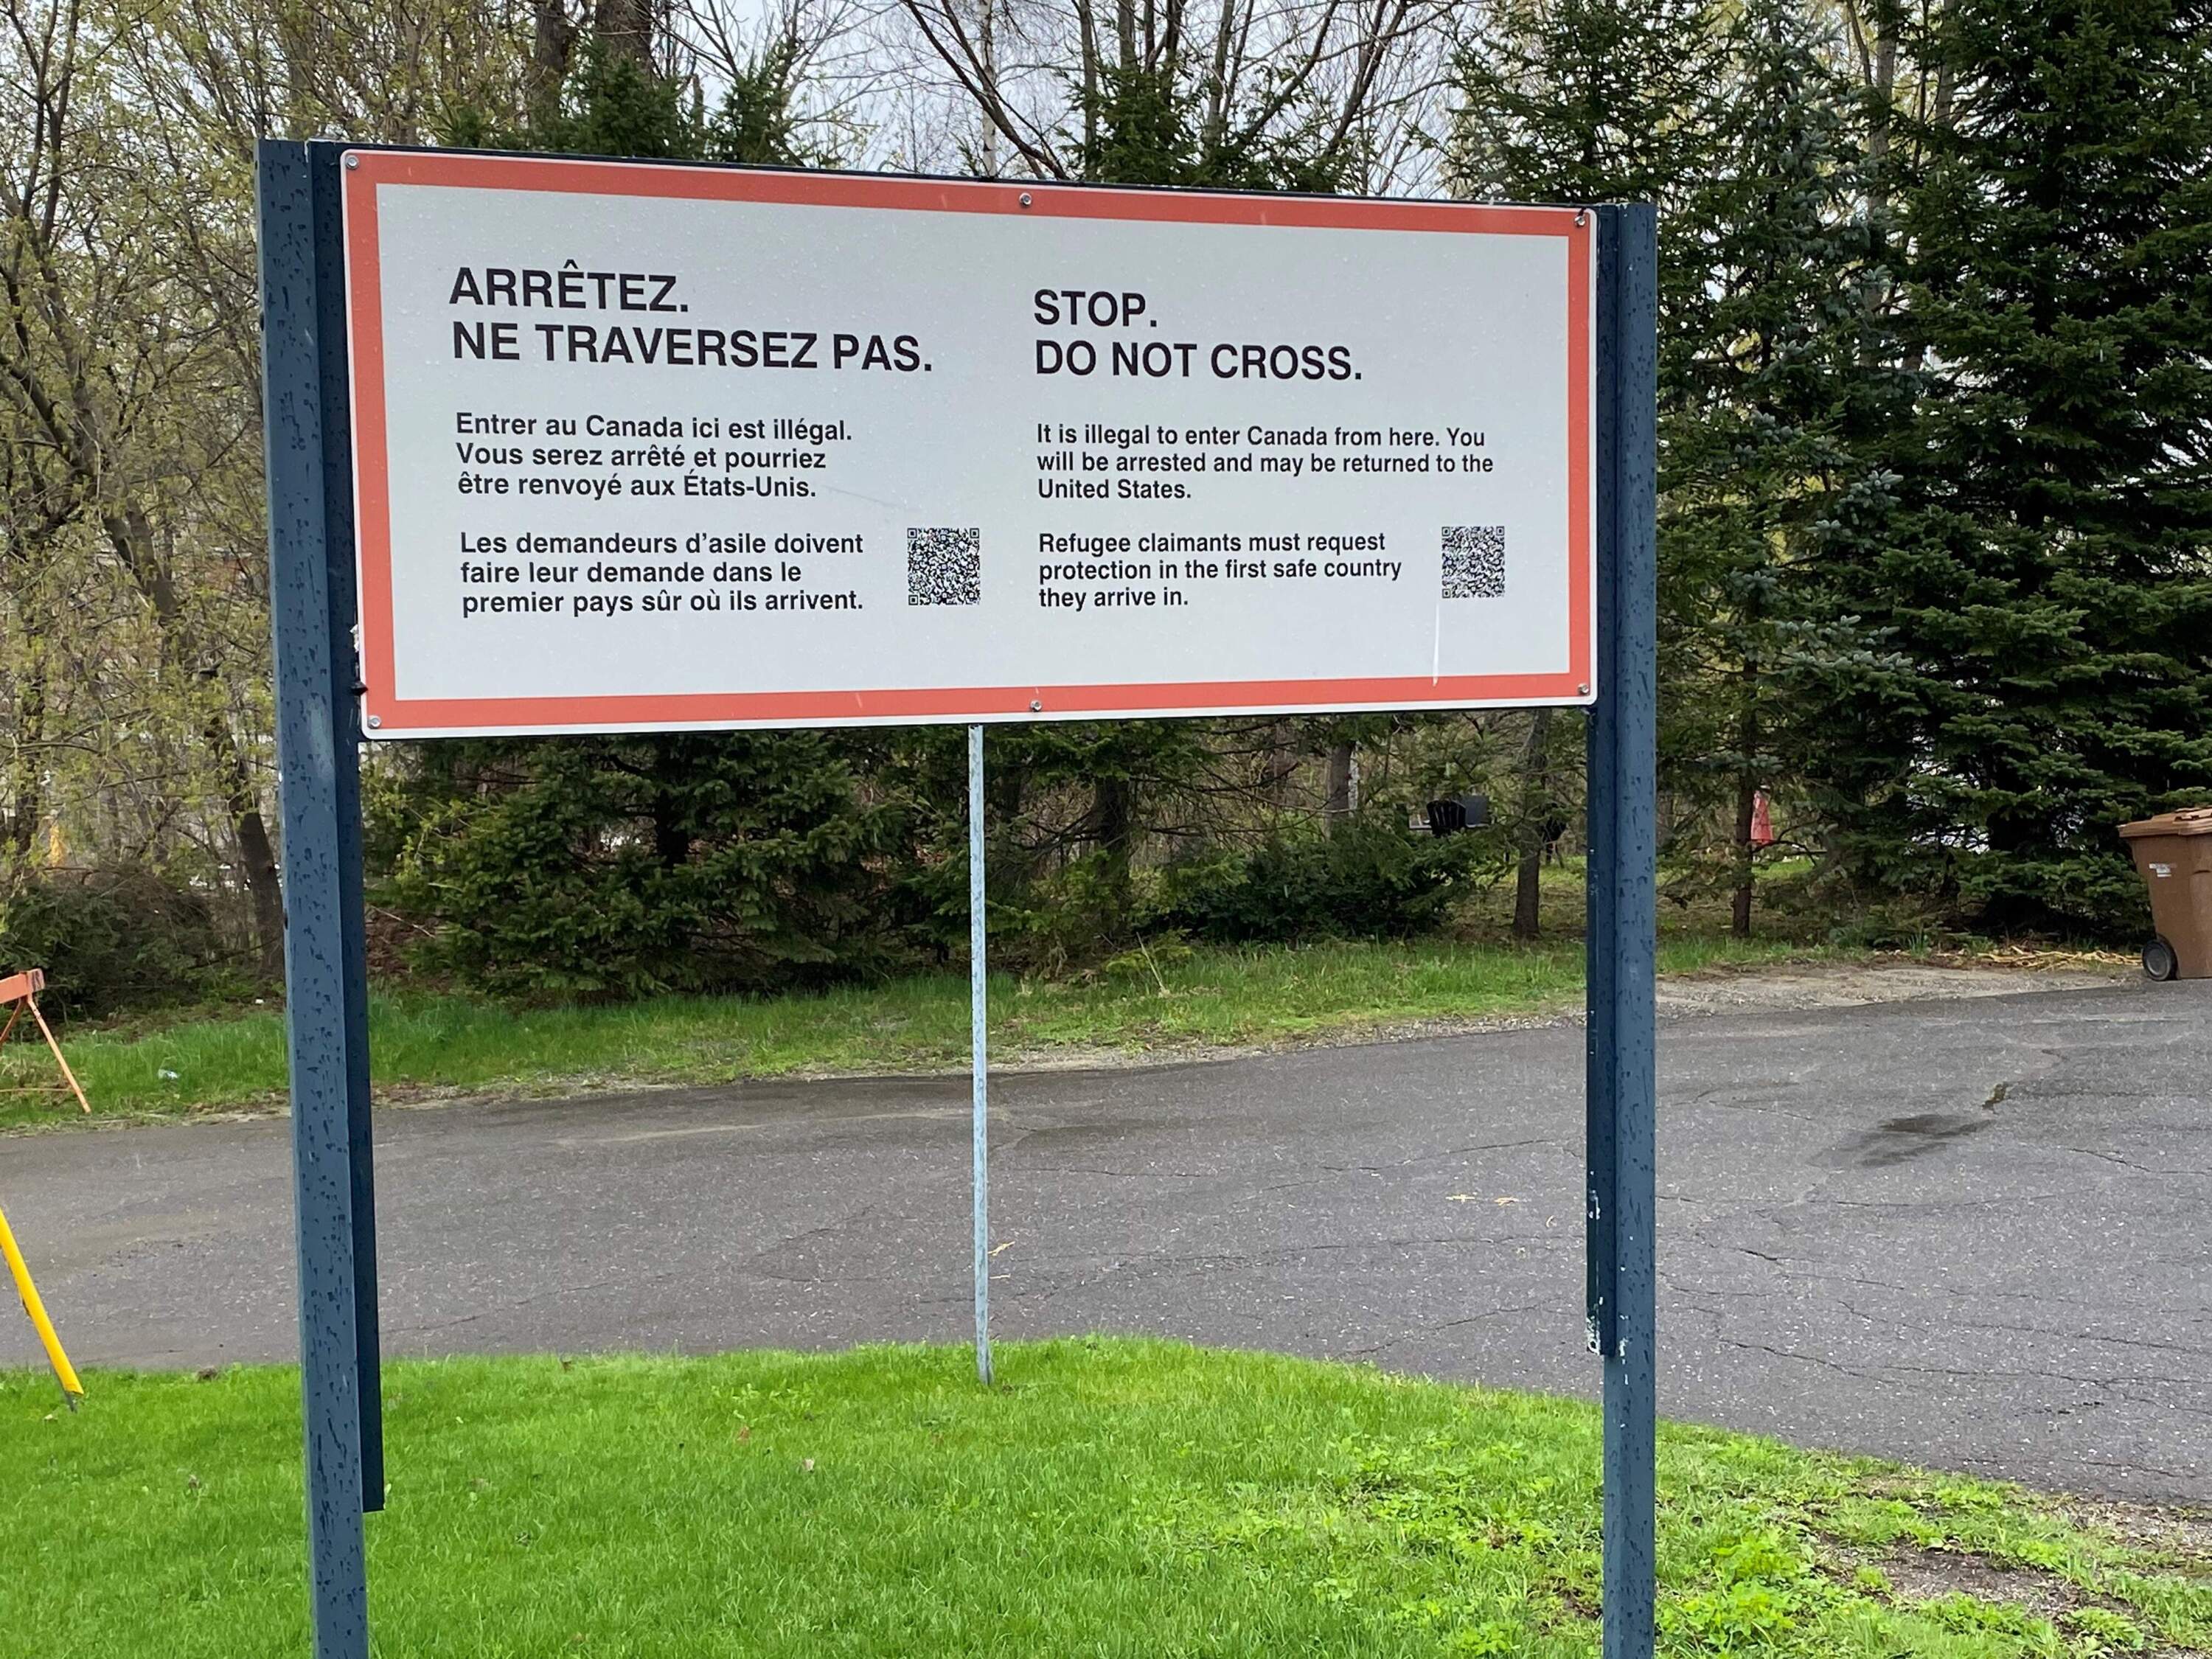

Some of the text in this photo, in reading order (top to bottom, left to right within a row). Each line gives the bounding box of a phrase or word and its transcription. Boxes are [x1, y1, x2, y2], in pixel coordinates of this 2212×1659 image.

[449, 259, 688, 312] ARRÊTEZ.
[1034, 289, 1156, 327] STOP.
[453, 321, 931, 372] NE TRAVERSEZ PAS.
[1037, 340, 1361, 380] DO NOT CROSS.
[456, 412, 851, 445] Entrer au Canada ici est illégal.
[1038, 424, 1484, 449] It is illegal to enter Canada from here. You
[456, 442, 826, 473] Vous serez arrêté et pourriez
[1037, 451, 1492, 476] will be arrested and may be returned to the
[459, 469, 815, 501] être renvoyé aux États-Unis.
[1039, 479, 1190, 499] United States.
[462, 532, 507, 554] Les
[517, 532, 677, 554] demandeurs
[775, 533, 863, 554] doivent
[1040, 532, 1385, 557] Refugee claimants must request
[461, 562, 801, 582] faire leur demande dans le
[1040, 559, 1401, 585] protection in the first safe country
[463, 589, 862, 618] premier pays sûr où ils arrivent.
[1039, 587, 1187, 611] they arrive in.
